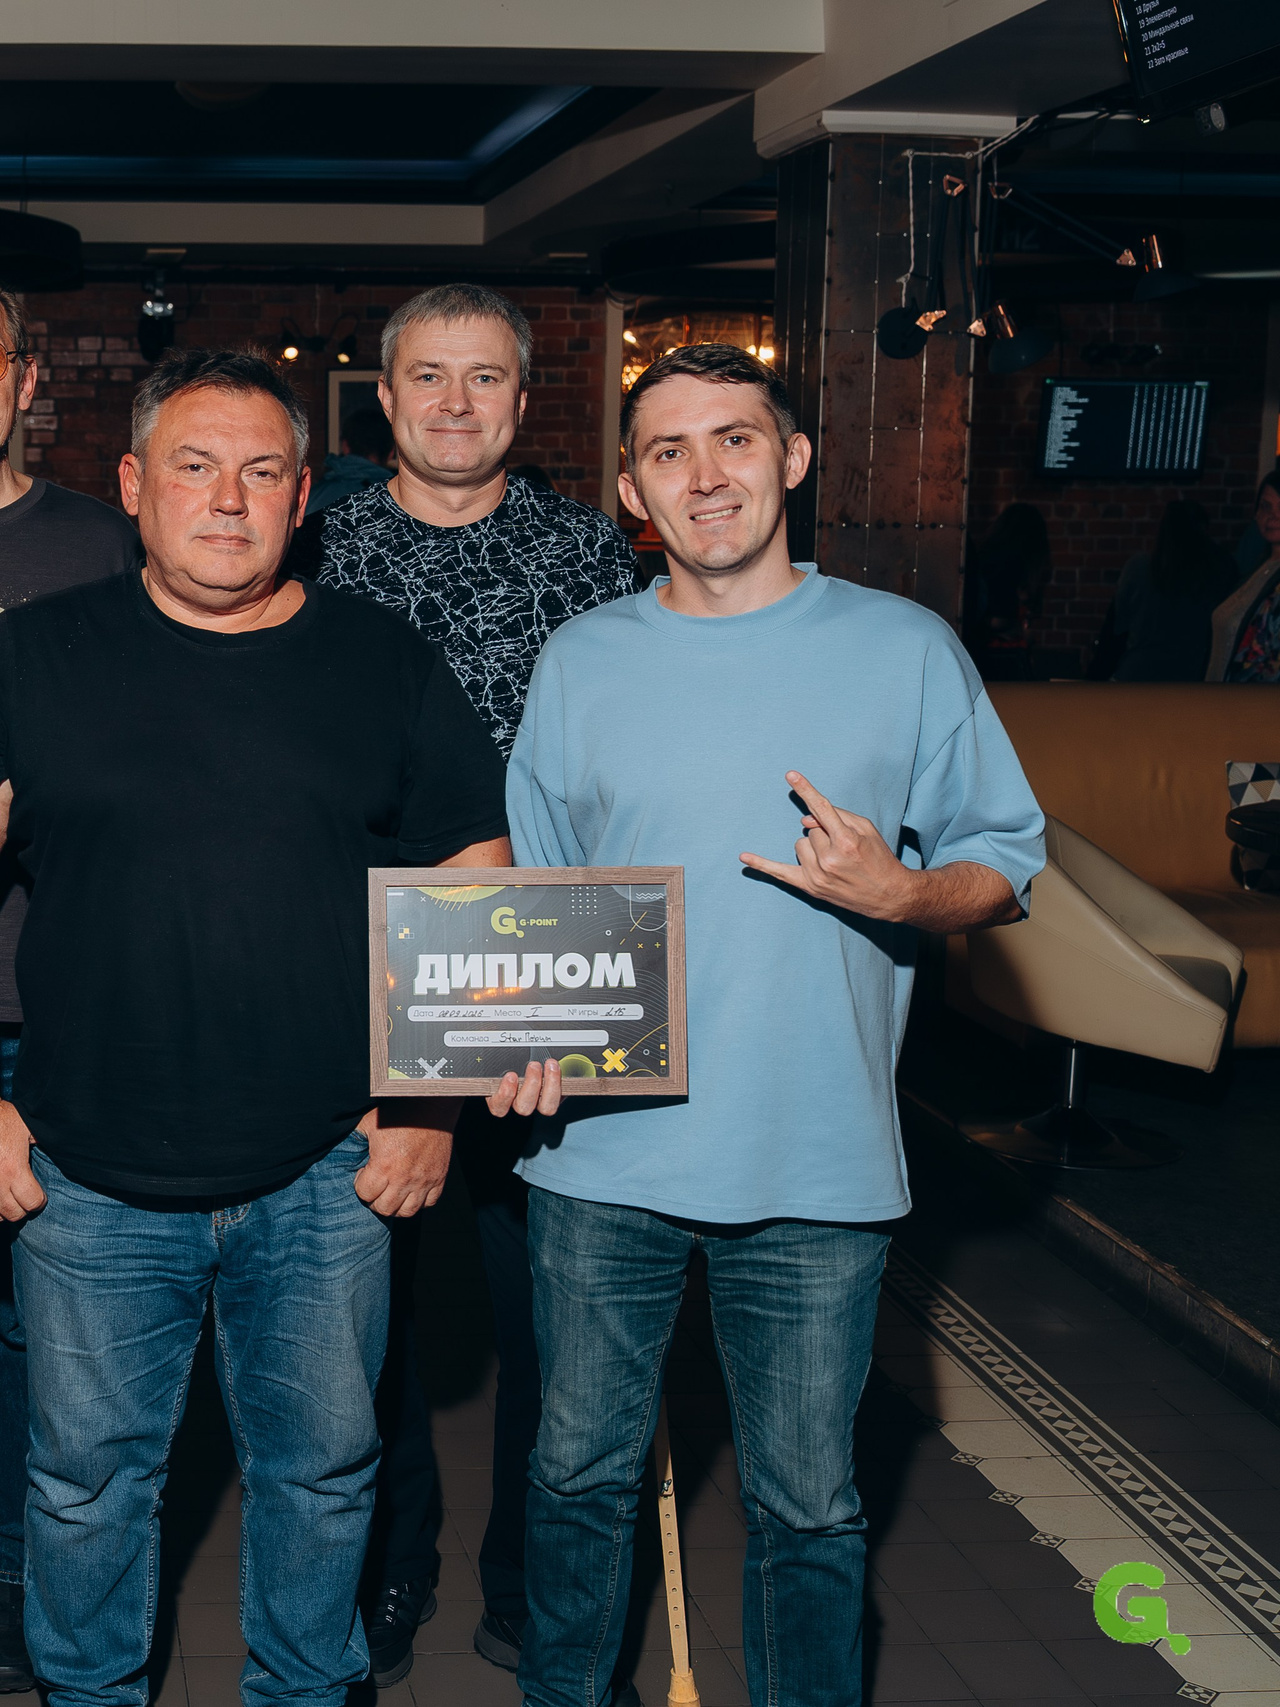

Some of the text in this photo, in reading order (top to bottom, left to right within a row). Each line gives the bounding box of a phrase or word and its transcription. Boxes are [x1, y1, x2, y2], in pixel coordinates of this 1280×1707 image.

[1139, 6, 1178, 29] 19 Элементарно
[1142, 14, 1195, 42] 20 Миндальные связи
[1144, 46, 1151, 56] 21
[1147, 59, 1154, 69] 22
[1165, 46, 1189, 63] красивые
[413, 952, 637, 996] ДИПЛОМ
[413, 1009, 434, 1018] Дата
[494, 1009, 522, 1017] Место
[578, 1009, 599, 1018] игры
[451, 1034, 490, 1043] Команда
[499, 1032, 522, 1043] Star
